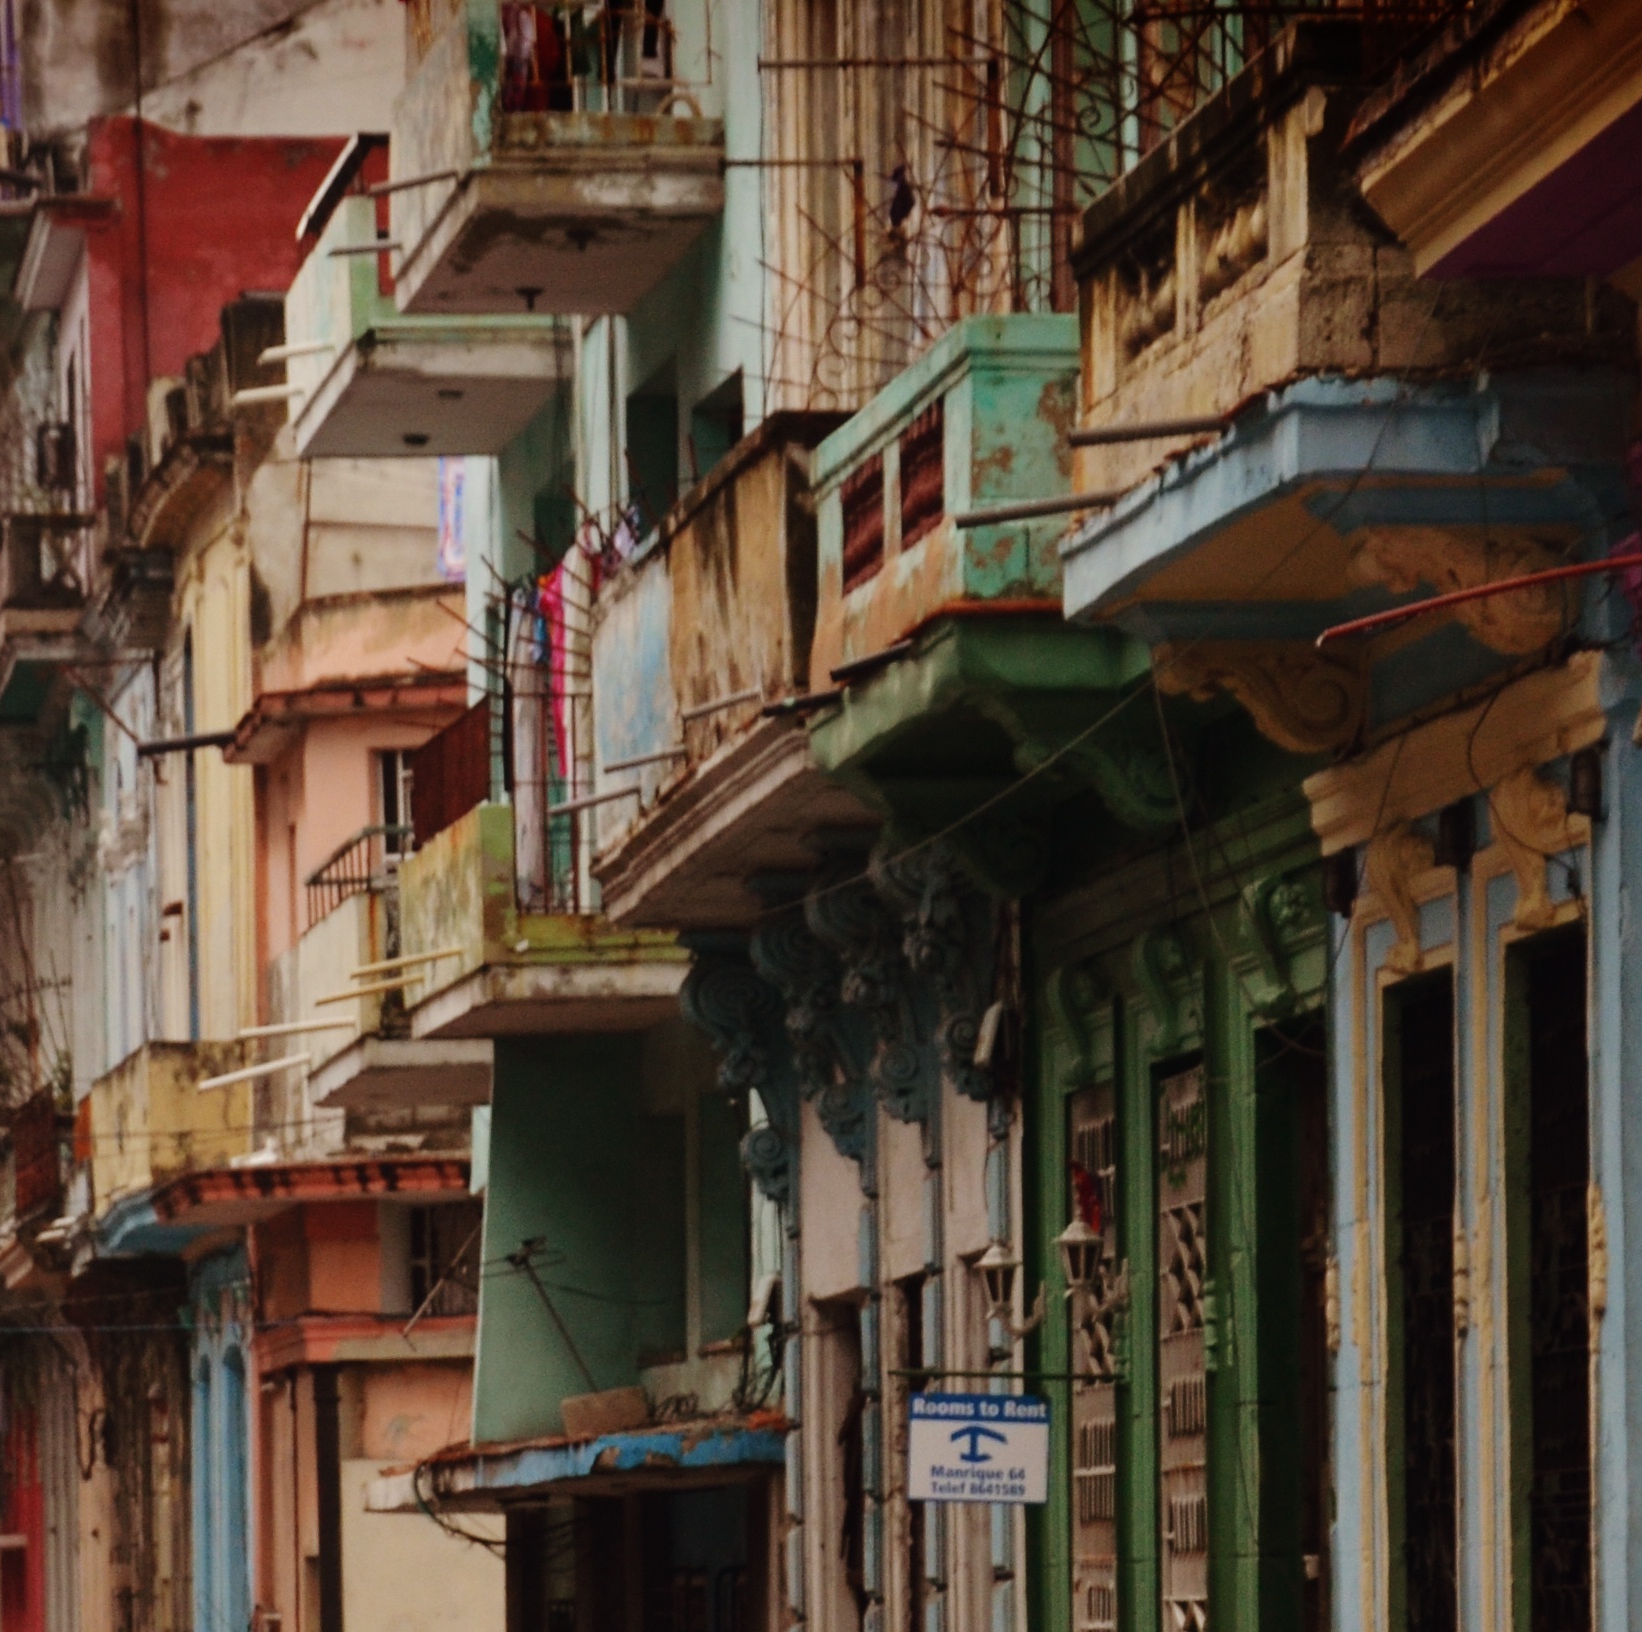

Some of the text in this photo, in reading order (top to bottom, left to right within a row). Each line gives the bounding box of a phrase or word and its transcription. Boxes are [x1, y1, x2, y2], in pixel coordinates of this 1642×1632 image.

[912, 1397, 1047, 1418] Rooms to Rent
[931, 1465, 1004, 1480] Manrique
[931, 1482, 965, 1494] Telef
